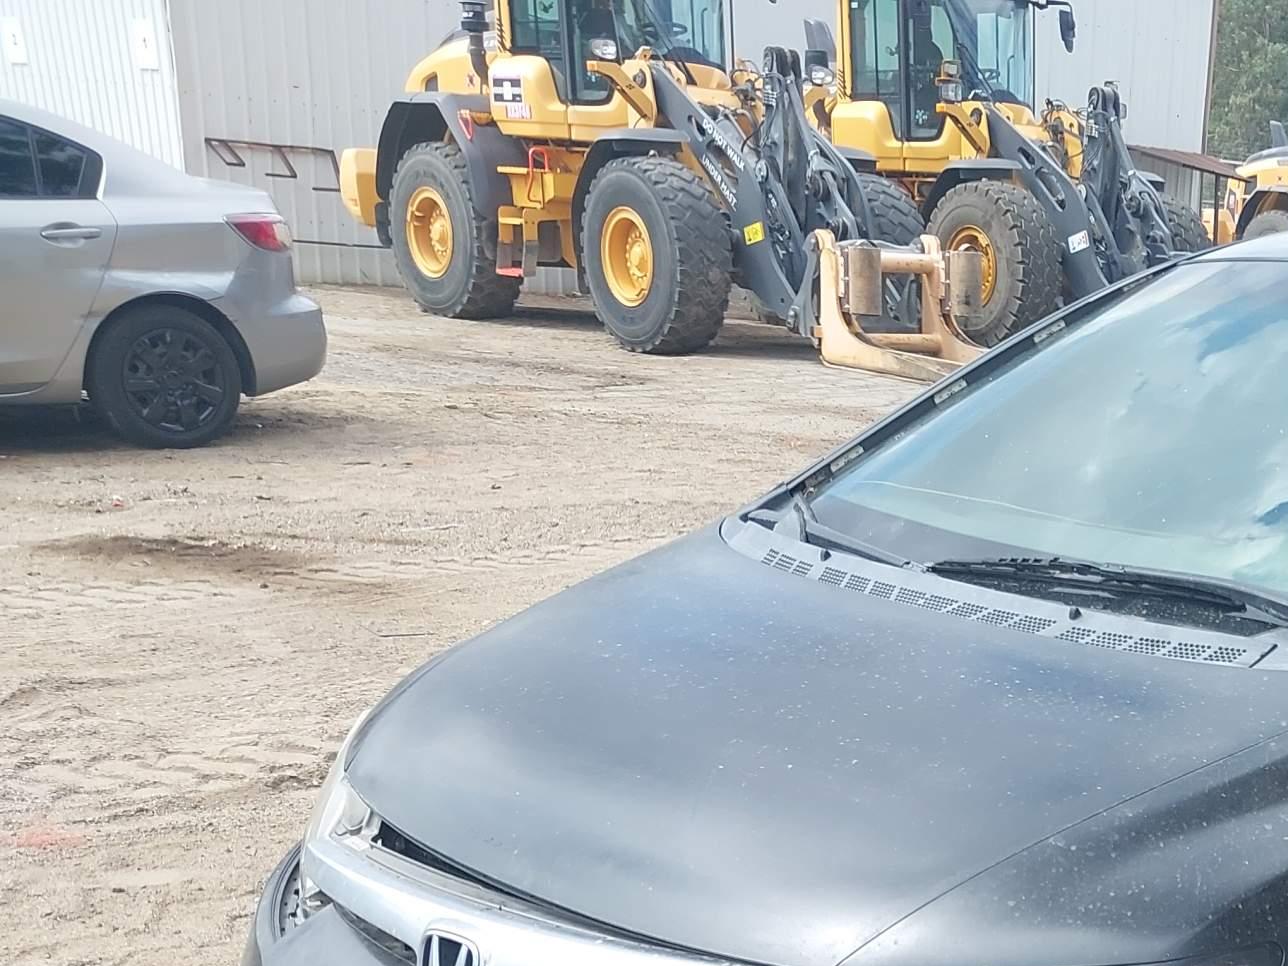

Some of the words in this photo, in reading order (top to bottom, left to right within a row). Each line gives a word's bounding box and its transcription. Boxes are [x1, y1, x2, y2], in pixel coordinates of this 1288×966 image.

[702, 118, 713, 135] DO
[712, 130, 727, 151] NOT
[726, 146, 745, 171] WALK
[702, 154, 721, 184] UNDER
